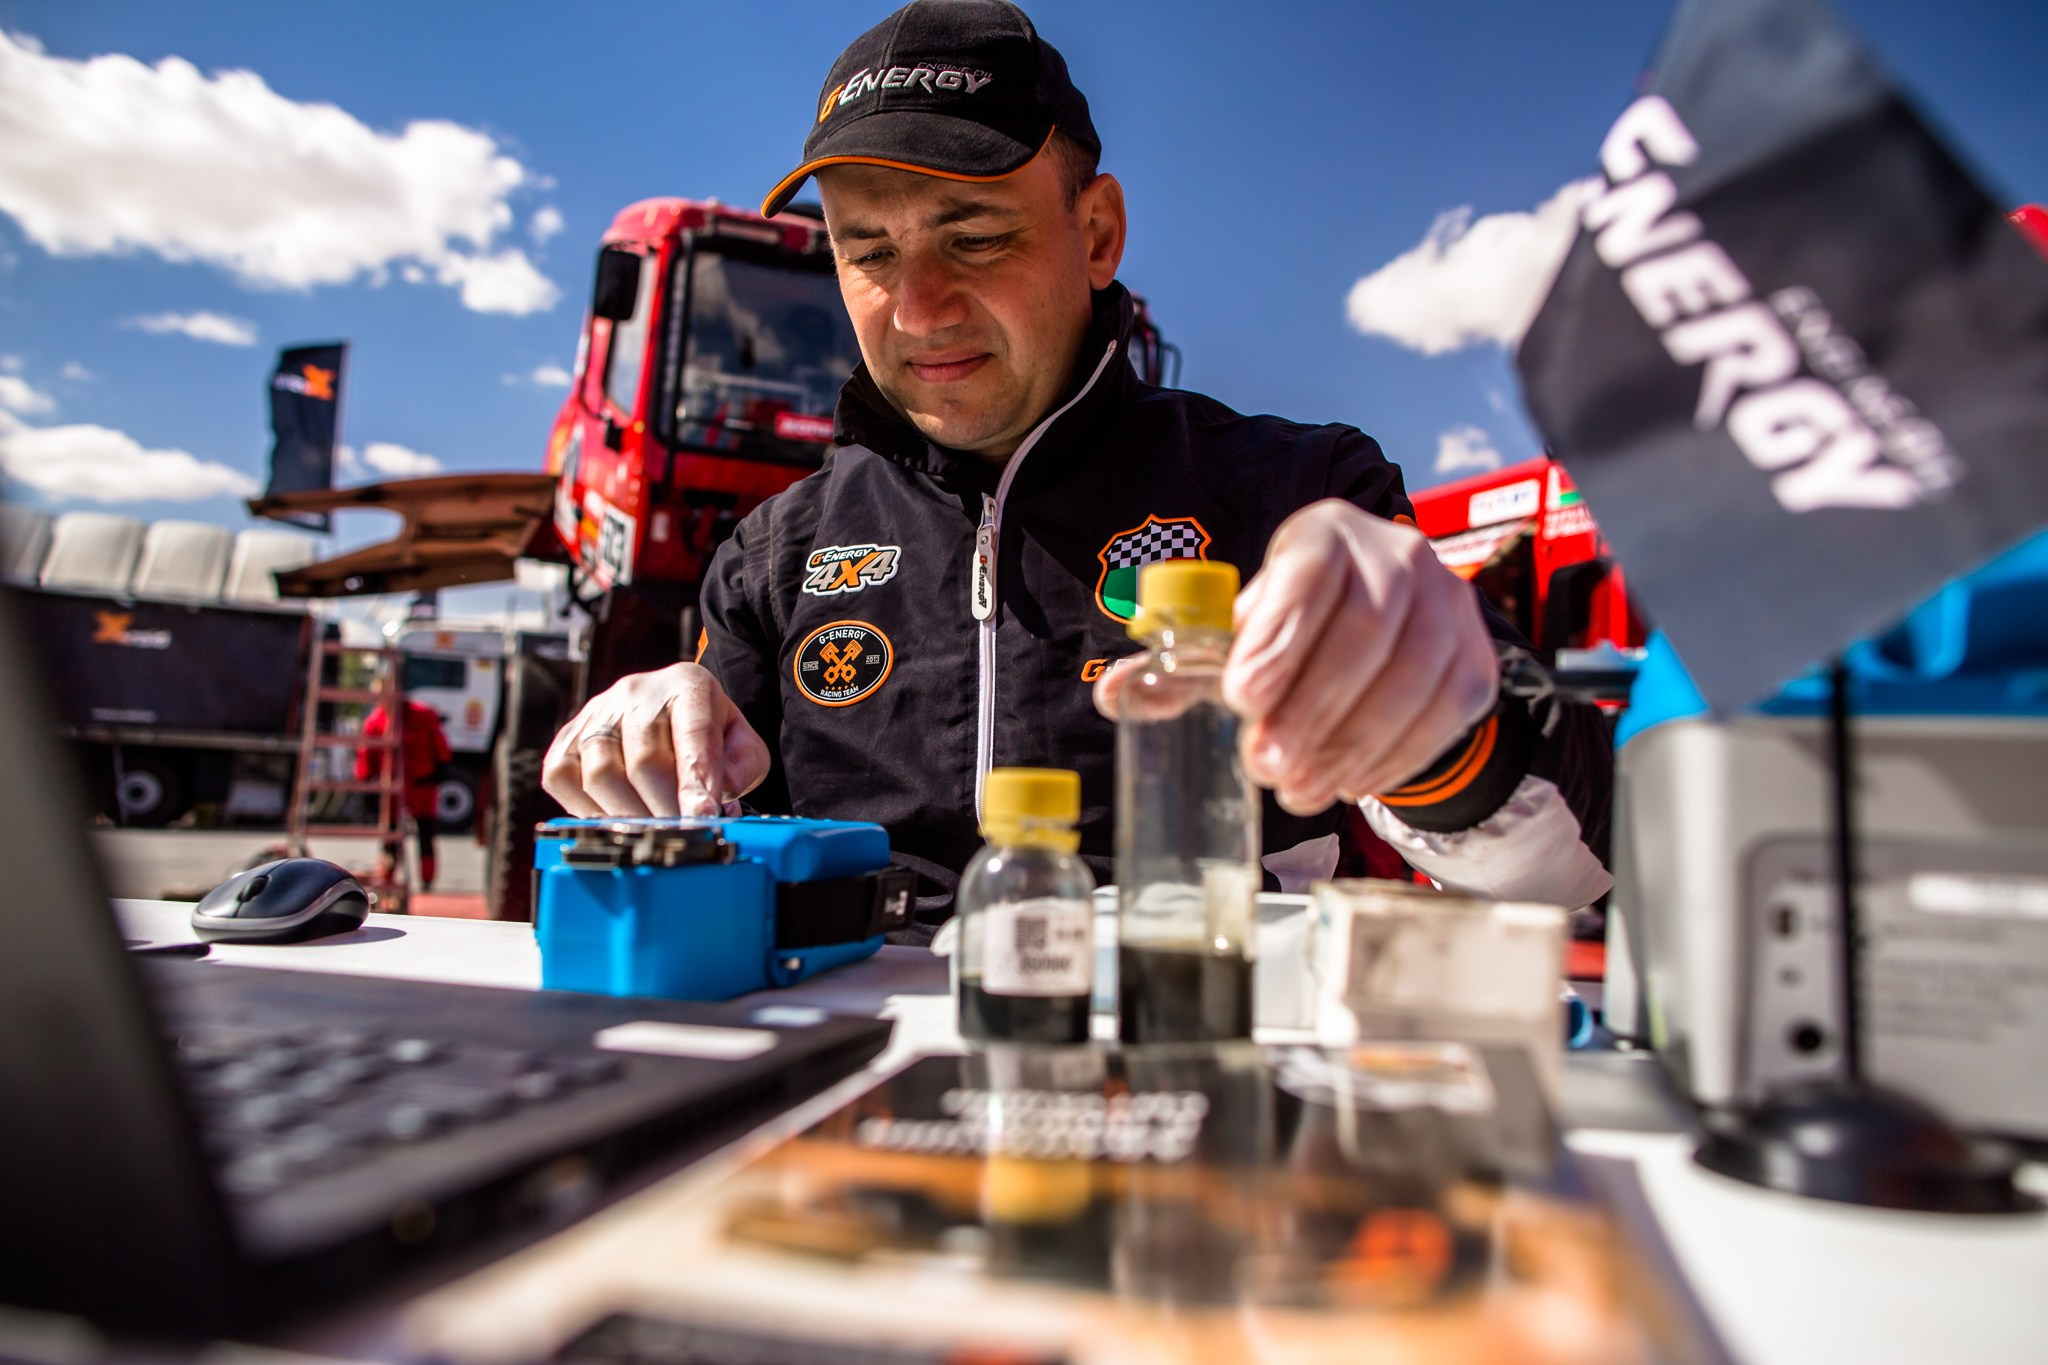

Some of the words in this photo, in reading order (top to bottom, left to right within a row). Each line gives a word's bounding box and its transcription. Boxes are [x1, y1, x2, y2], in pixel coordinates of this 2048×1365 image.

[917, 62, 970, 74] ENGINE
[819, 629, 867, 645] G-ENERGY
[802, 661, 819, 671] SINCE
[820, 689, 842, 698] RACING
[843, 685, 859, 696] TEAM
